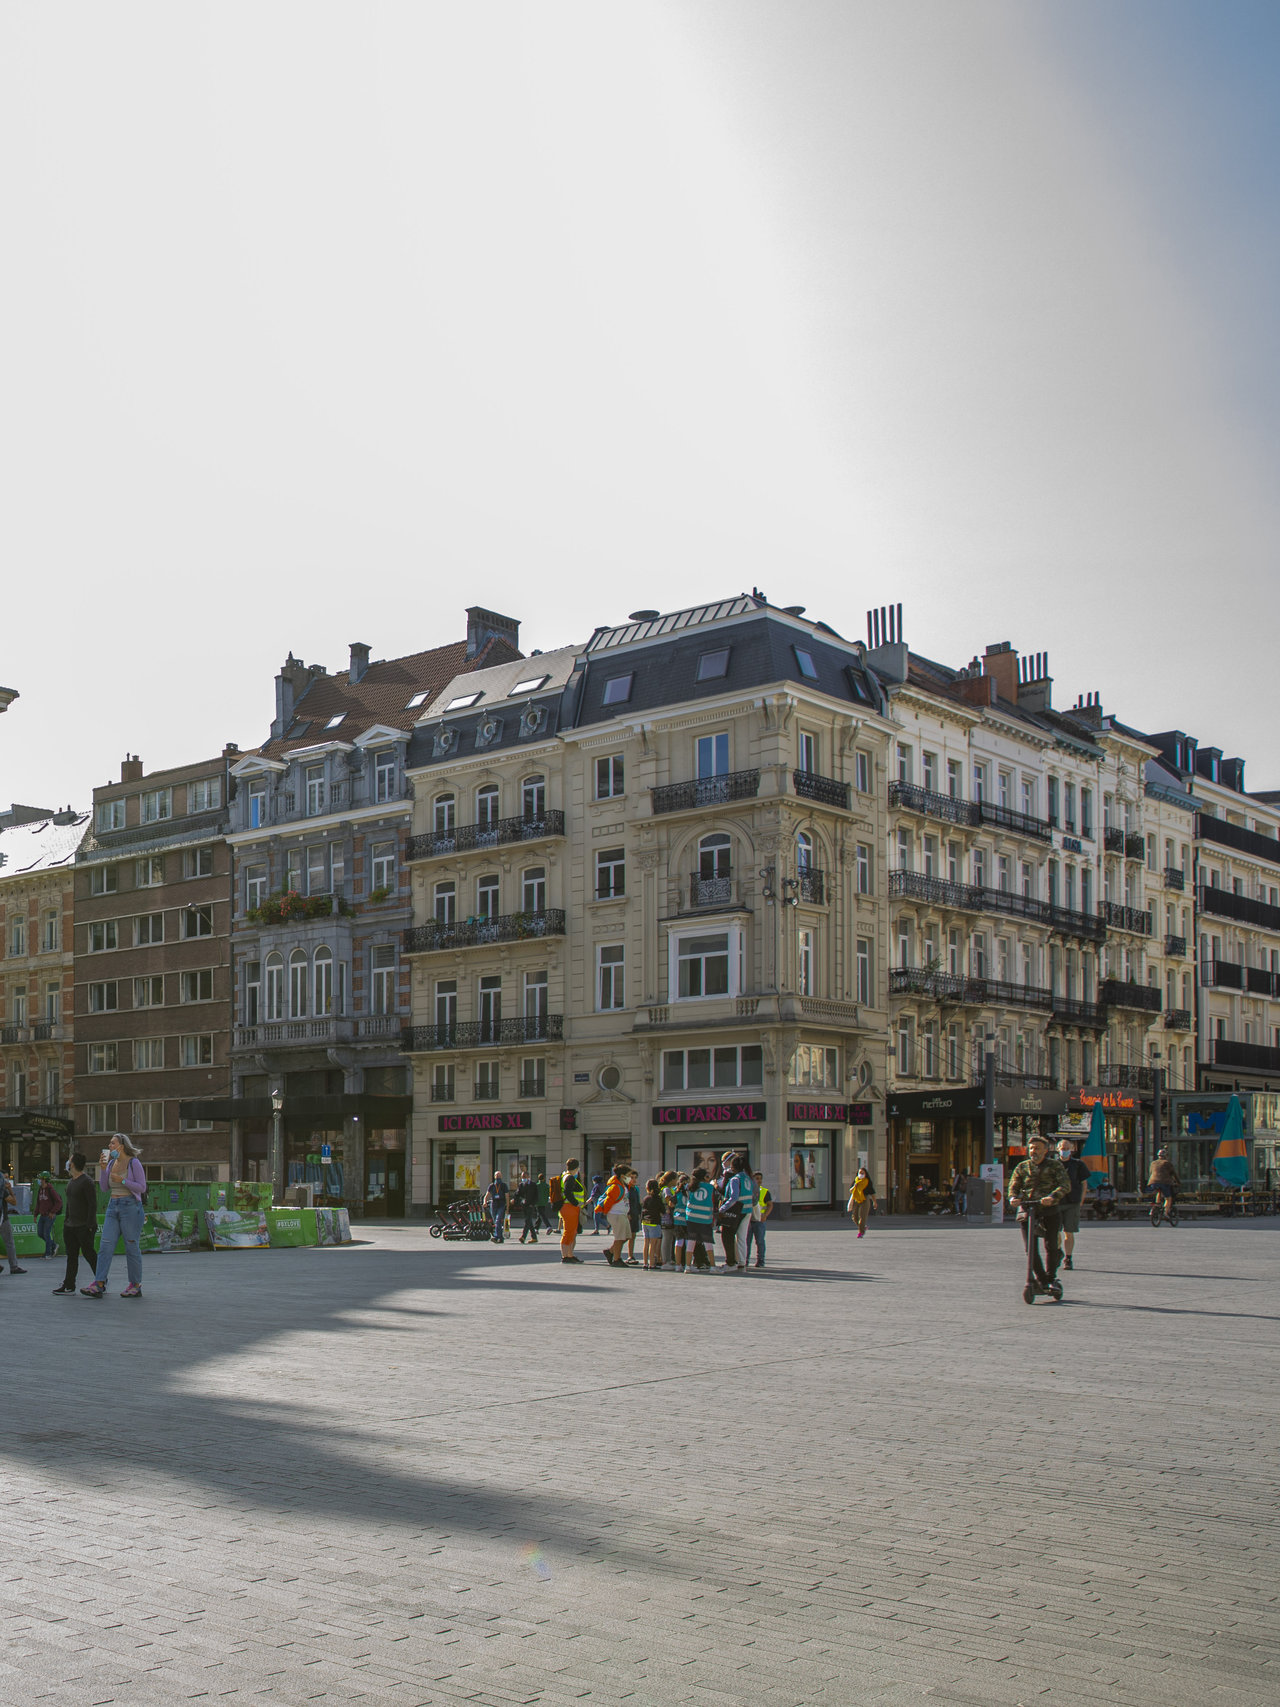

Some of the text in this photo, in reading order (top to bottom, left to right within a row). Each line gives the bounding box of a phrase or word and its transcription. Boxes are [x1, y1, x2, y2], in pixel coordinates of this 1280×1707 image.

[659, 1105, 757, 1123] ICI PARIS XL
[794, 1104, 846, 1120] ICI PARIS XL
[444, 1114, 524, 1130] ICI PARIS XL
